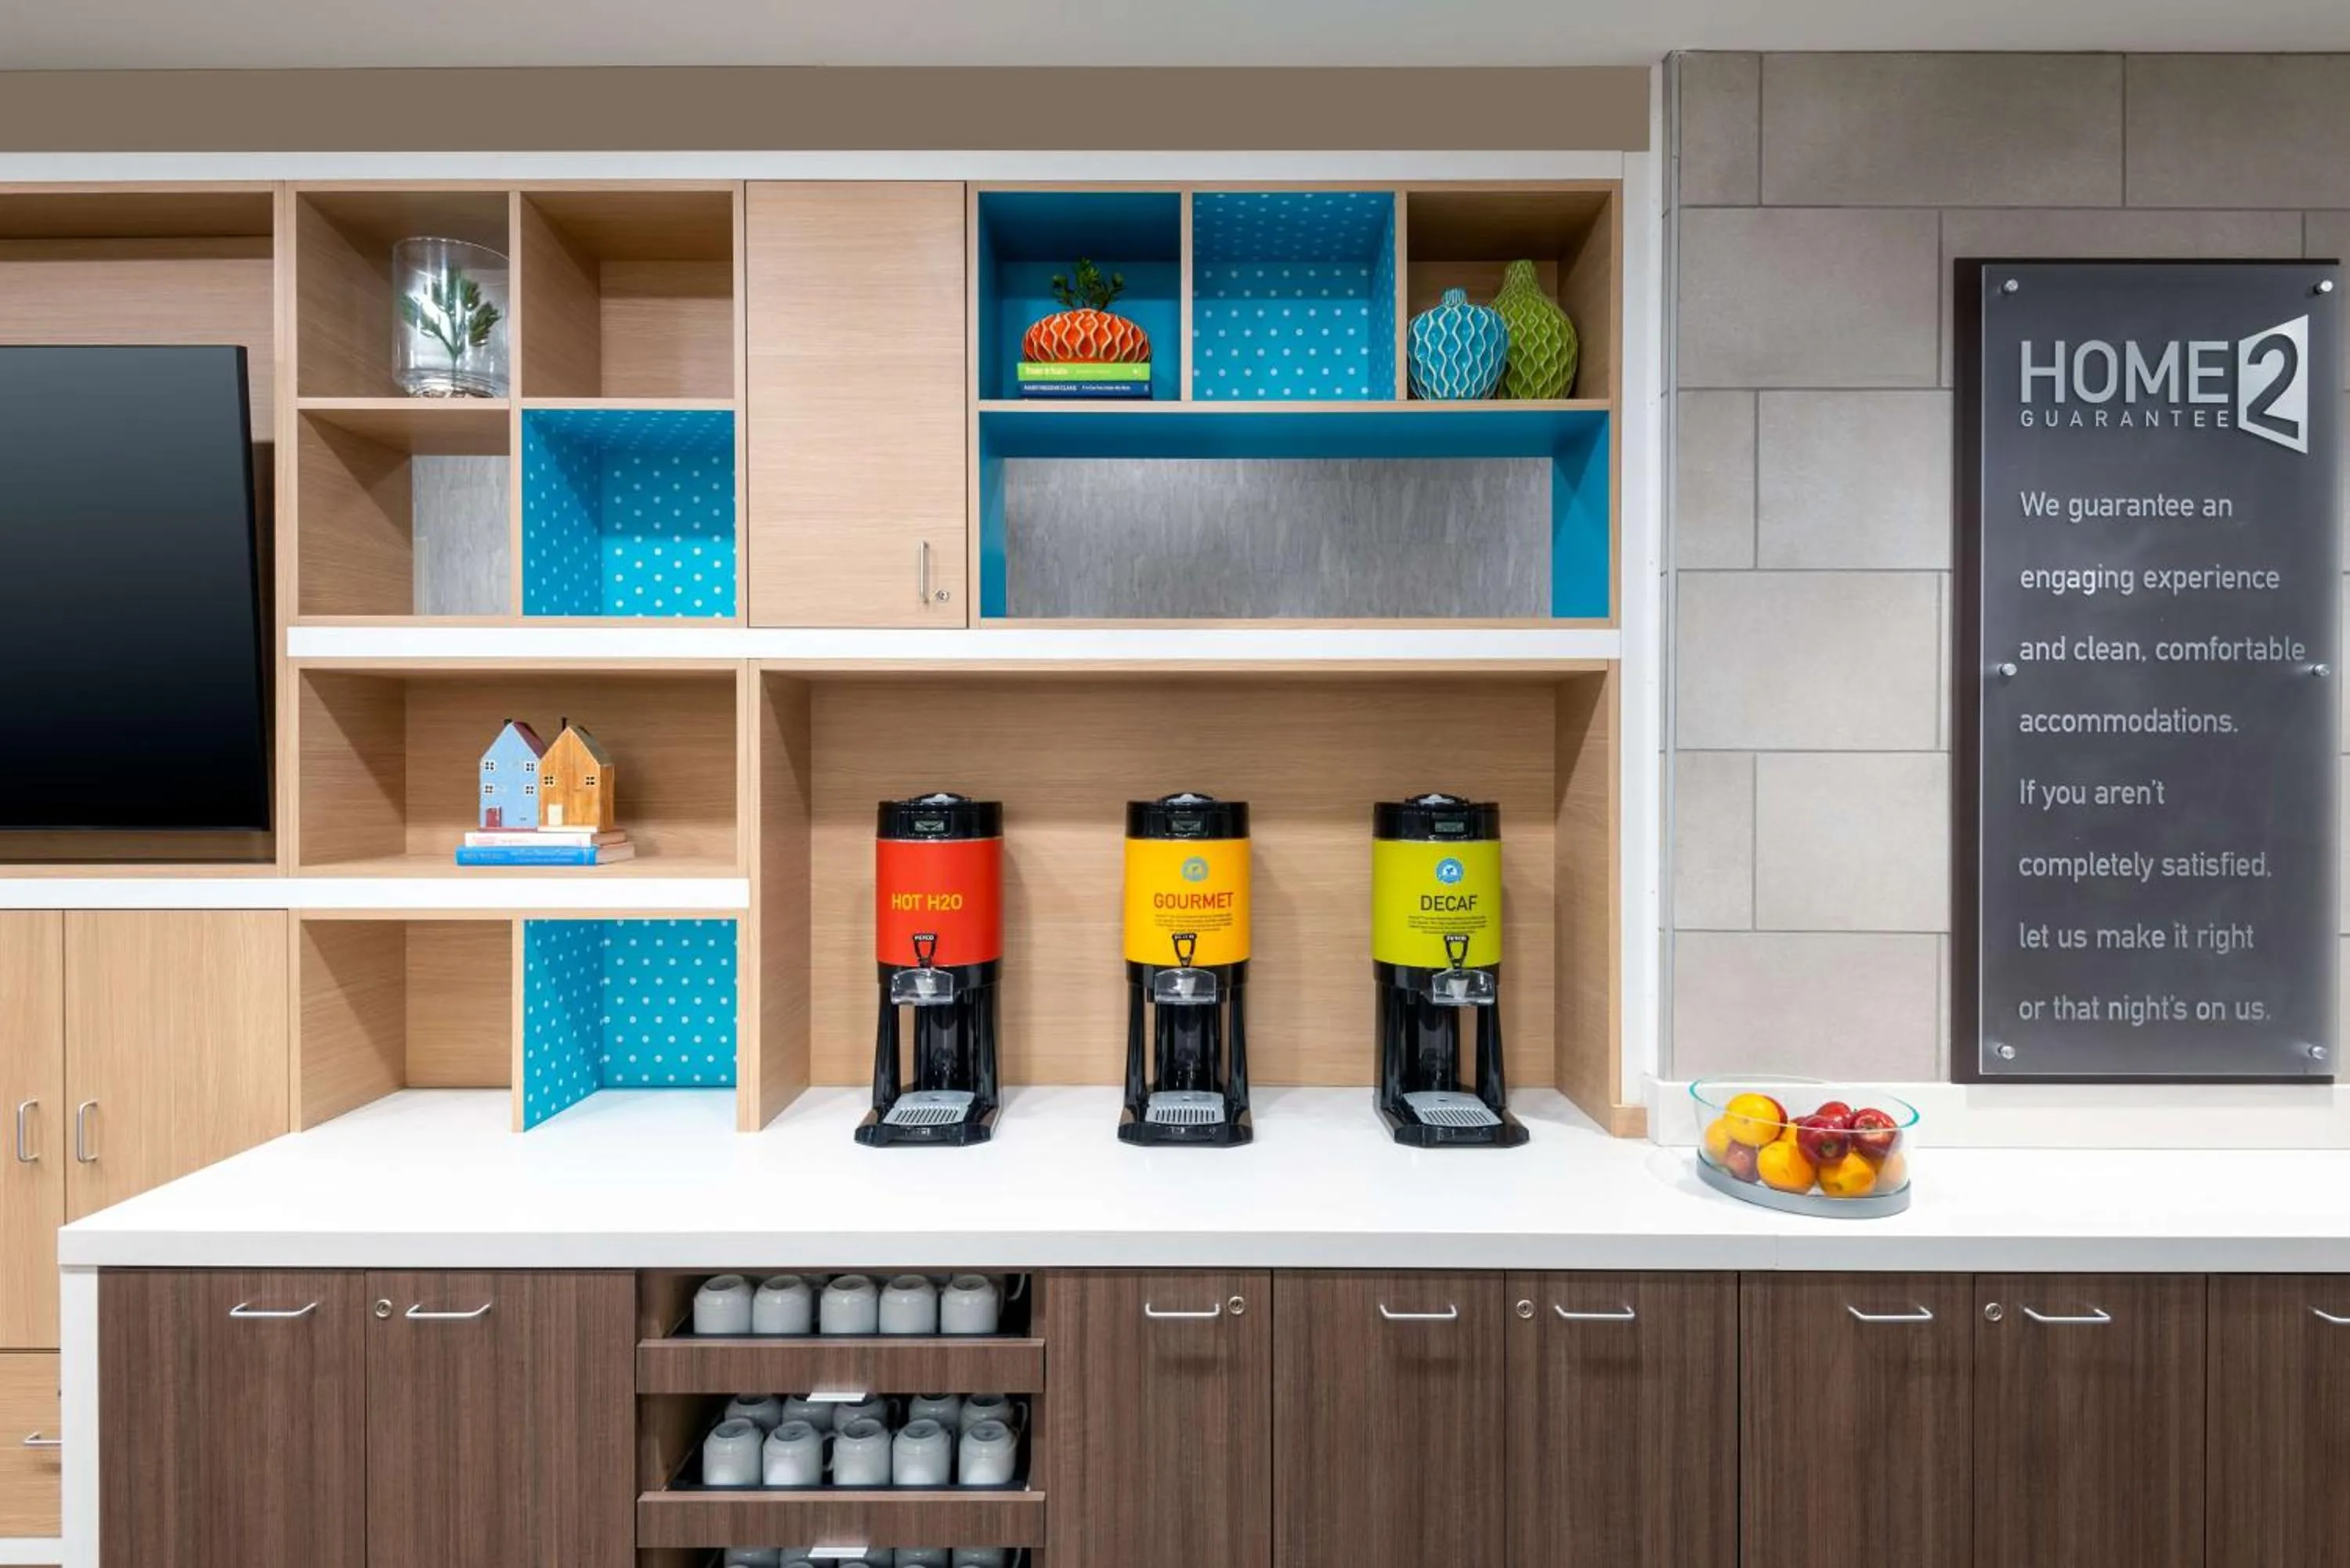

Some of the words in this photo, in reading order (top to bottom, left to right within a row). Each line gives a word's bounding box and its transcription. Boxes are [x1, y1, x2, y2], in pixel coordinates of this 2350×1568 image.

[2020, 410, 2229, 428] GUARANTEE
[2020, 491, 2060, 517] We
[2069, 493, 2195, 523] guarantee
[2202, 498, 2232, 518] an
[2020, 564, 2135, 596] engaging
[2143, 564, 2280, 596] experience
[2019, 636, 2066, 663] and
[2073, 635, 2147, 665] clean,
[2155, 636, 2306, 663] comfortable
[2019, 707, 2239, 733] accommodations.
[2020, 779, 2036, 804] If
[2041, 785, 2086, 811] you
[2094, 779, 2165, 805] aren't
[2019, 851, 2155, 883] completely
[891, 893, 923, 911] HOT
[1153, 891, 1235, 909] GOURMET
[1420, 894, 1478, 911] DECAF
[2019, 922, 2049, 948] let
[2058, 929, 2088, 948] us
[2096, 922, 2166, 948] make
[2174, 922, 2189, 948] it
[2197, 923, 2254, 955] right
[2019, 1001, 2046, 1021] or
[2053, 994, 2100, 1021] that
[2108, 994, 2188, 1027] night's
[2196, 1001, 2226, 1021] on
[2236, 1001, 2272, 1021] us.
